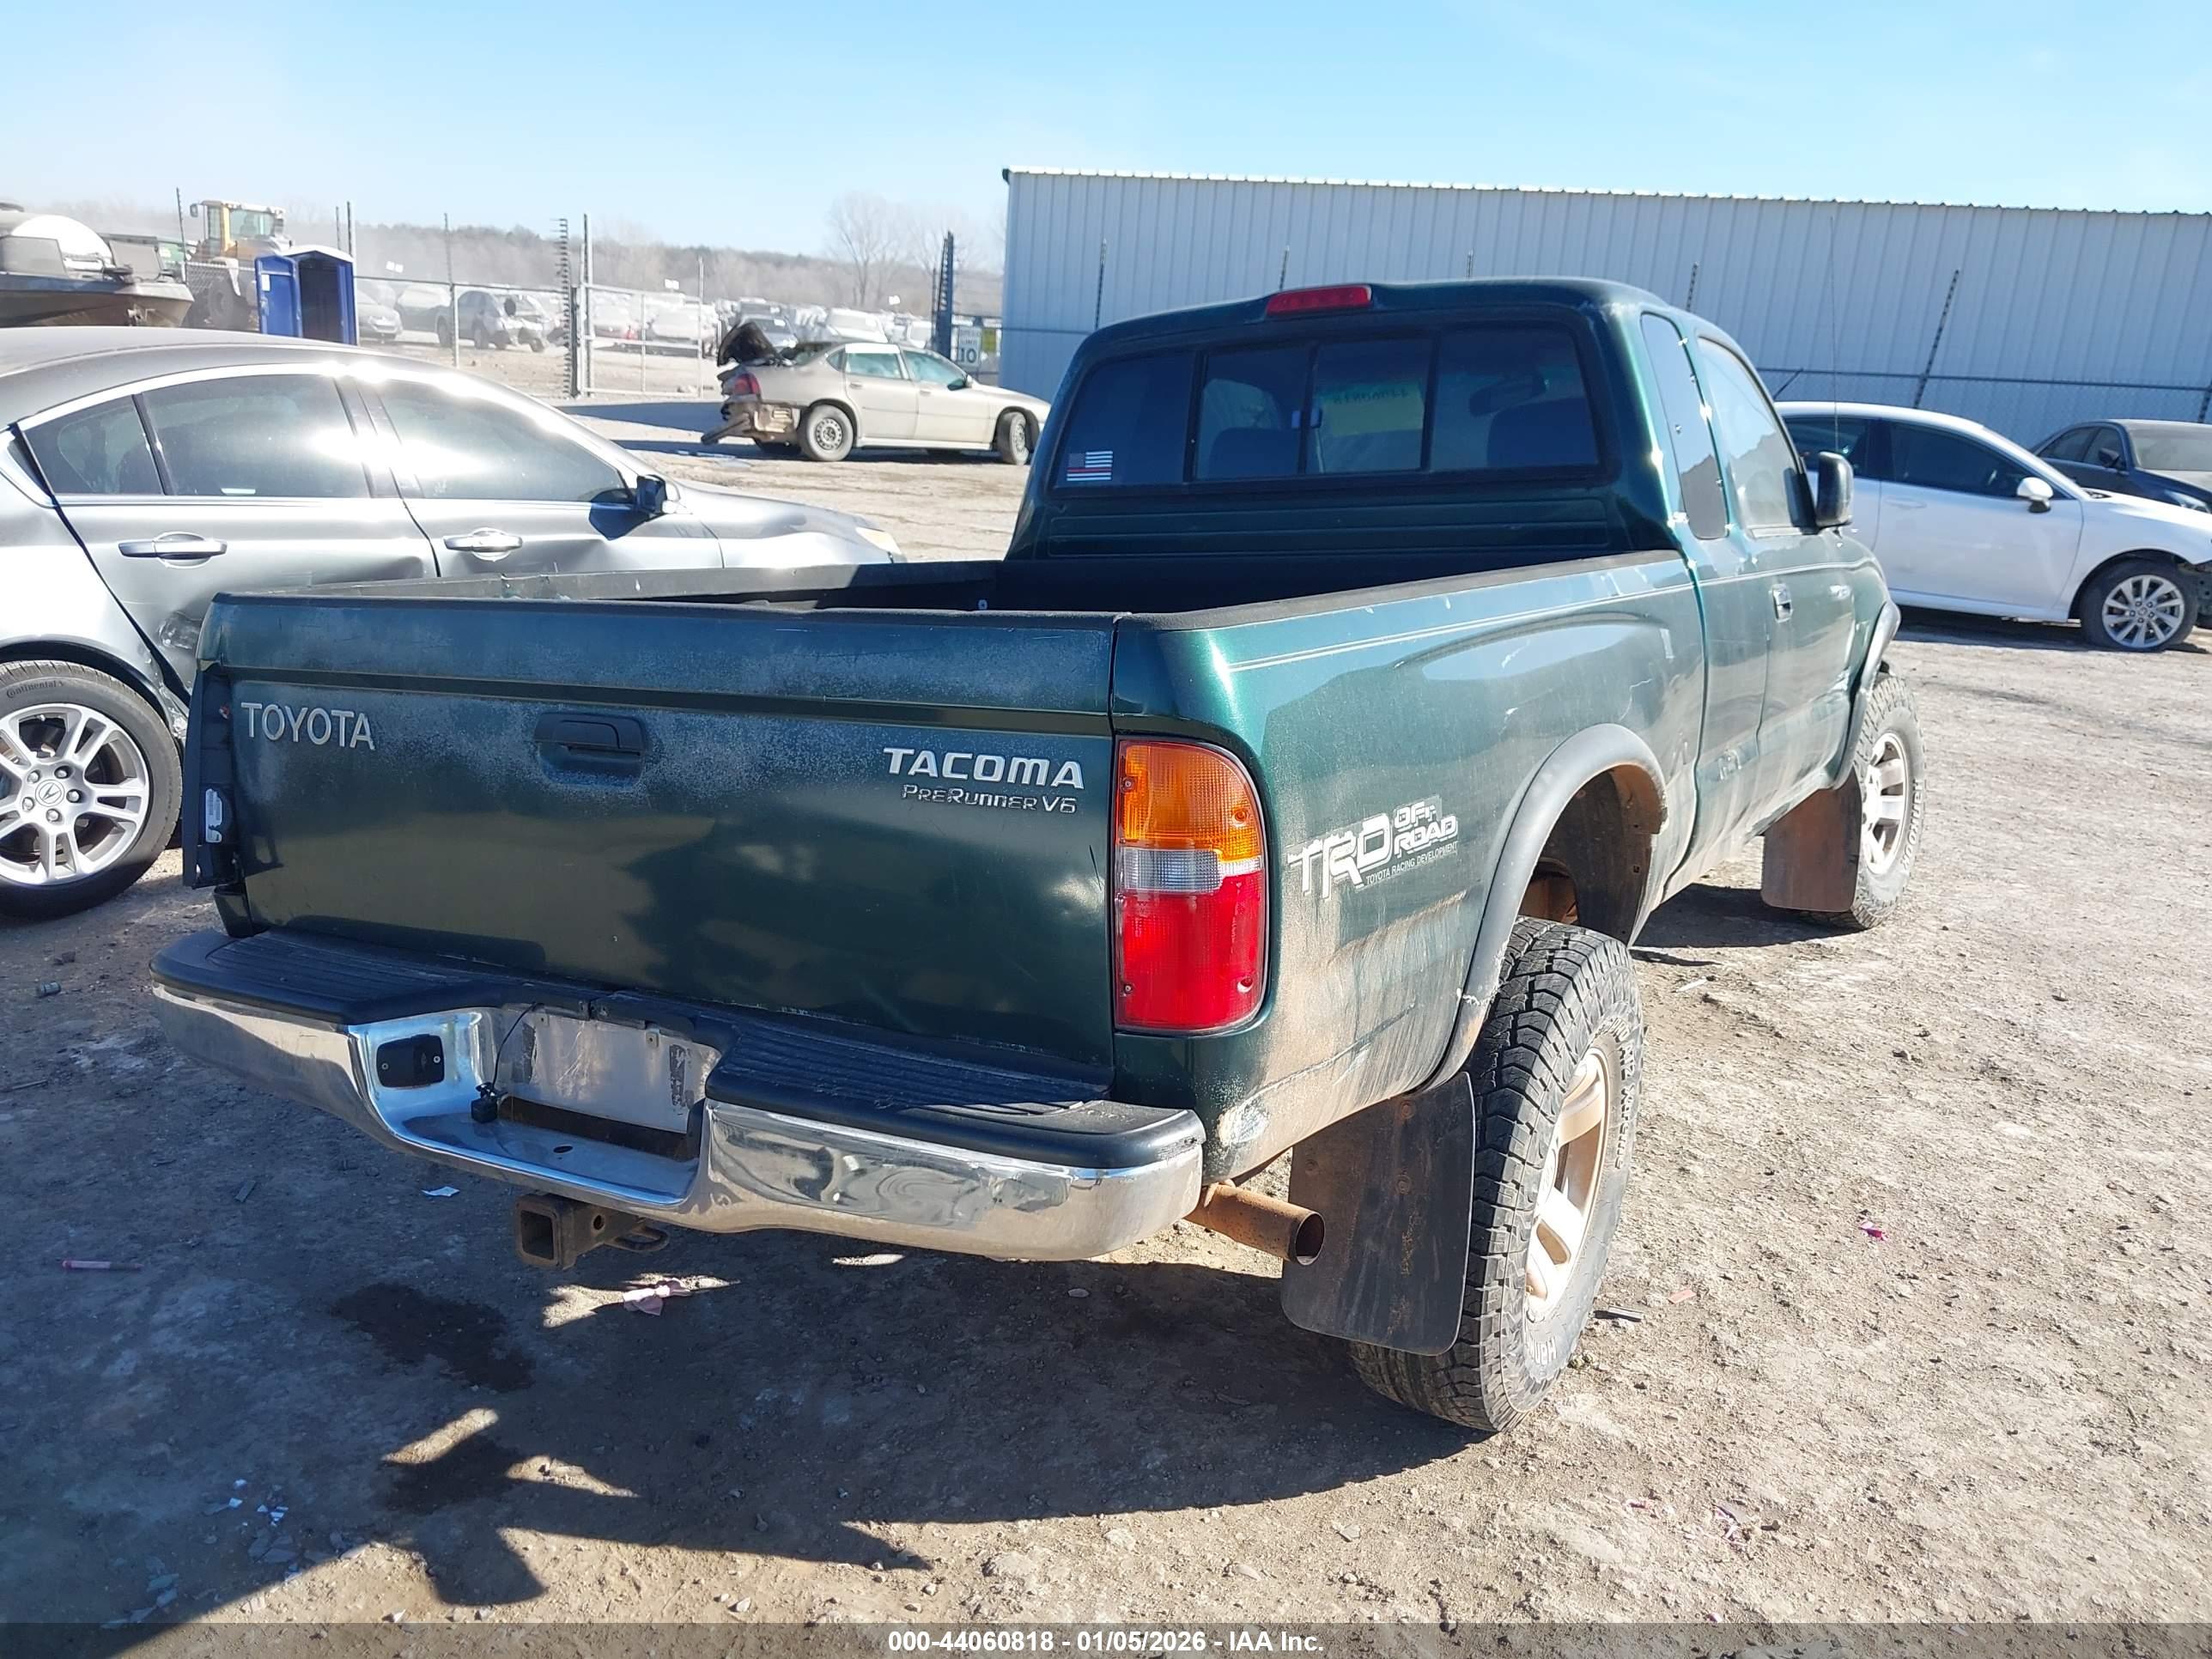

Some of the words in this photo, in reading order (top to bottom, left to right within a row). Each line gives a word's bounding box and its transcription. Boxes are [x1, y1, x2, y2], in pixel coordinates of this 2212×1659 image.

[959, 348, 977, 363] 10
[240, 702, 375, 750] TOYOTA
[883, 747, 1085, 790] TACOMA
[1042, 796, 1077, 814] V6
[1287, 812, 1393, 903] TRD
[1395, 815, 1458, 857] ROAD
[1365, 868, 1390, 884] TOYOTA
[1391, 858, 1415, 873] RACING
[1416, 841, 1458, 865] DEVELOPMENT
